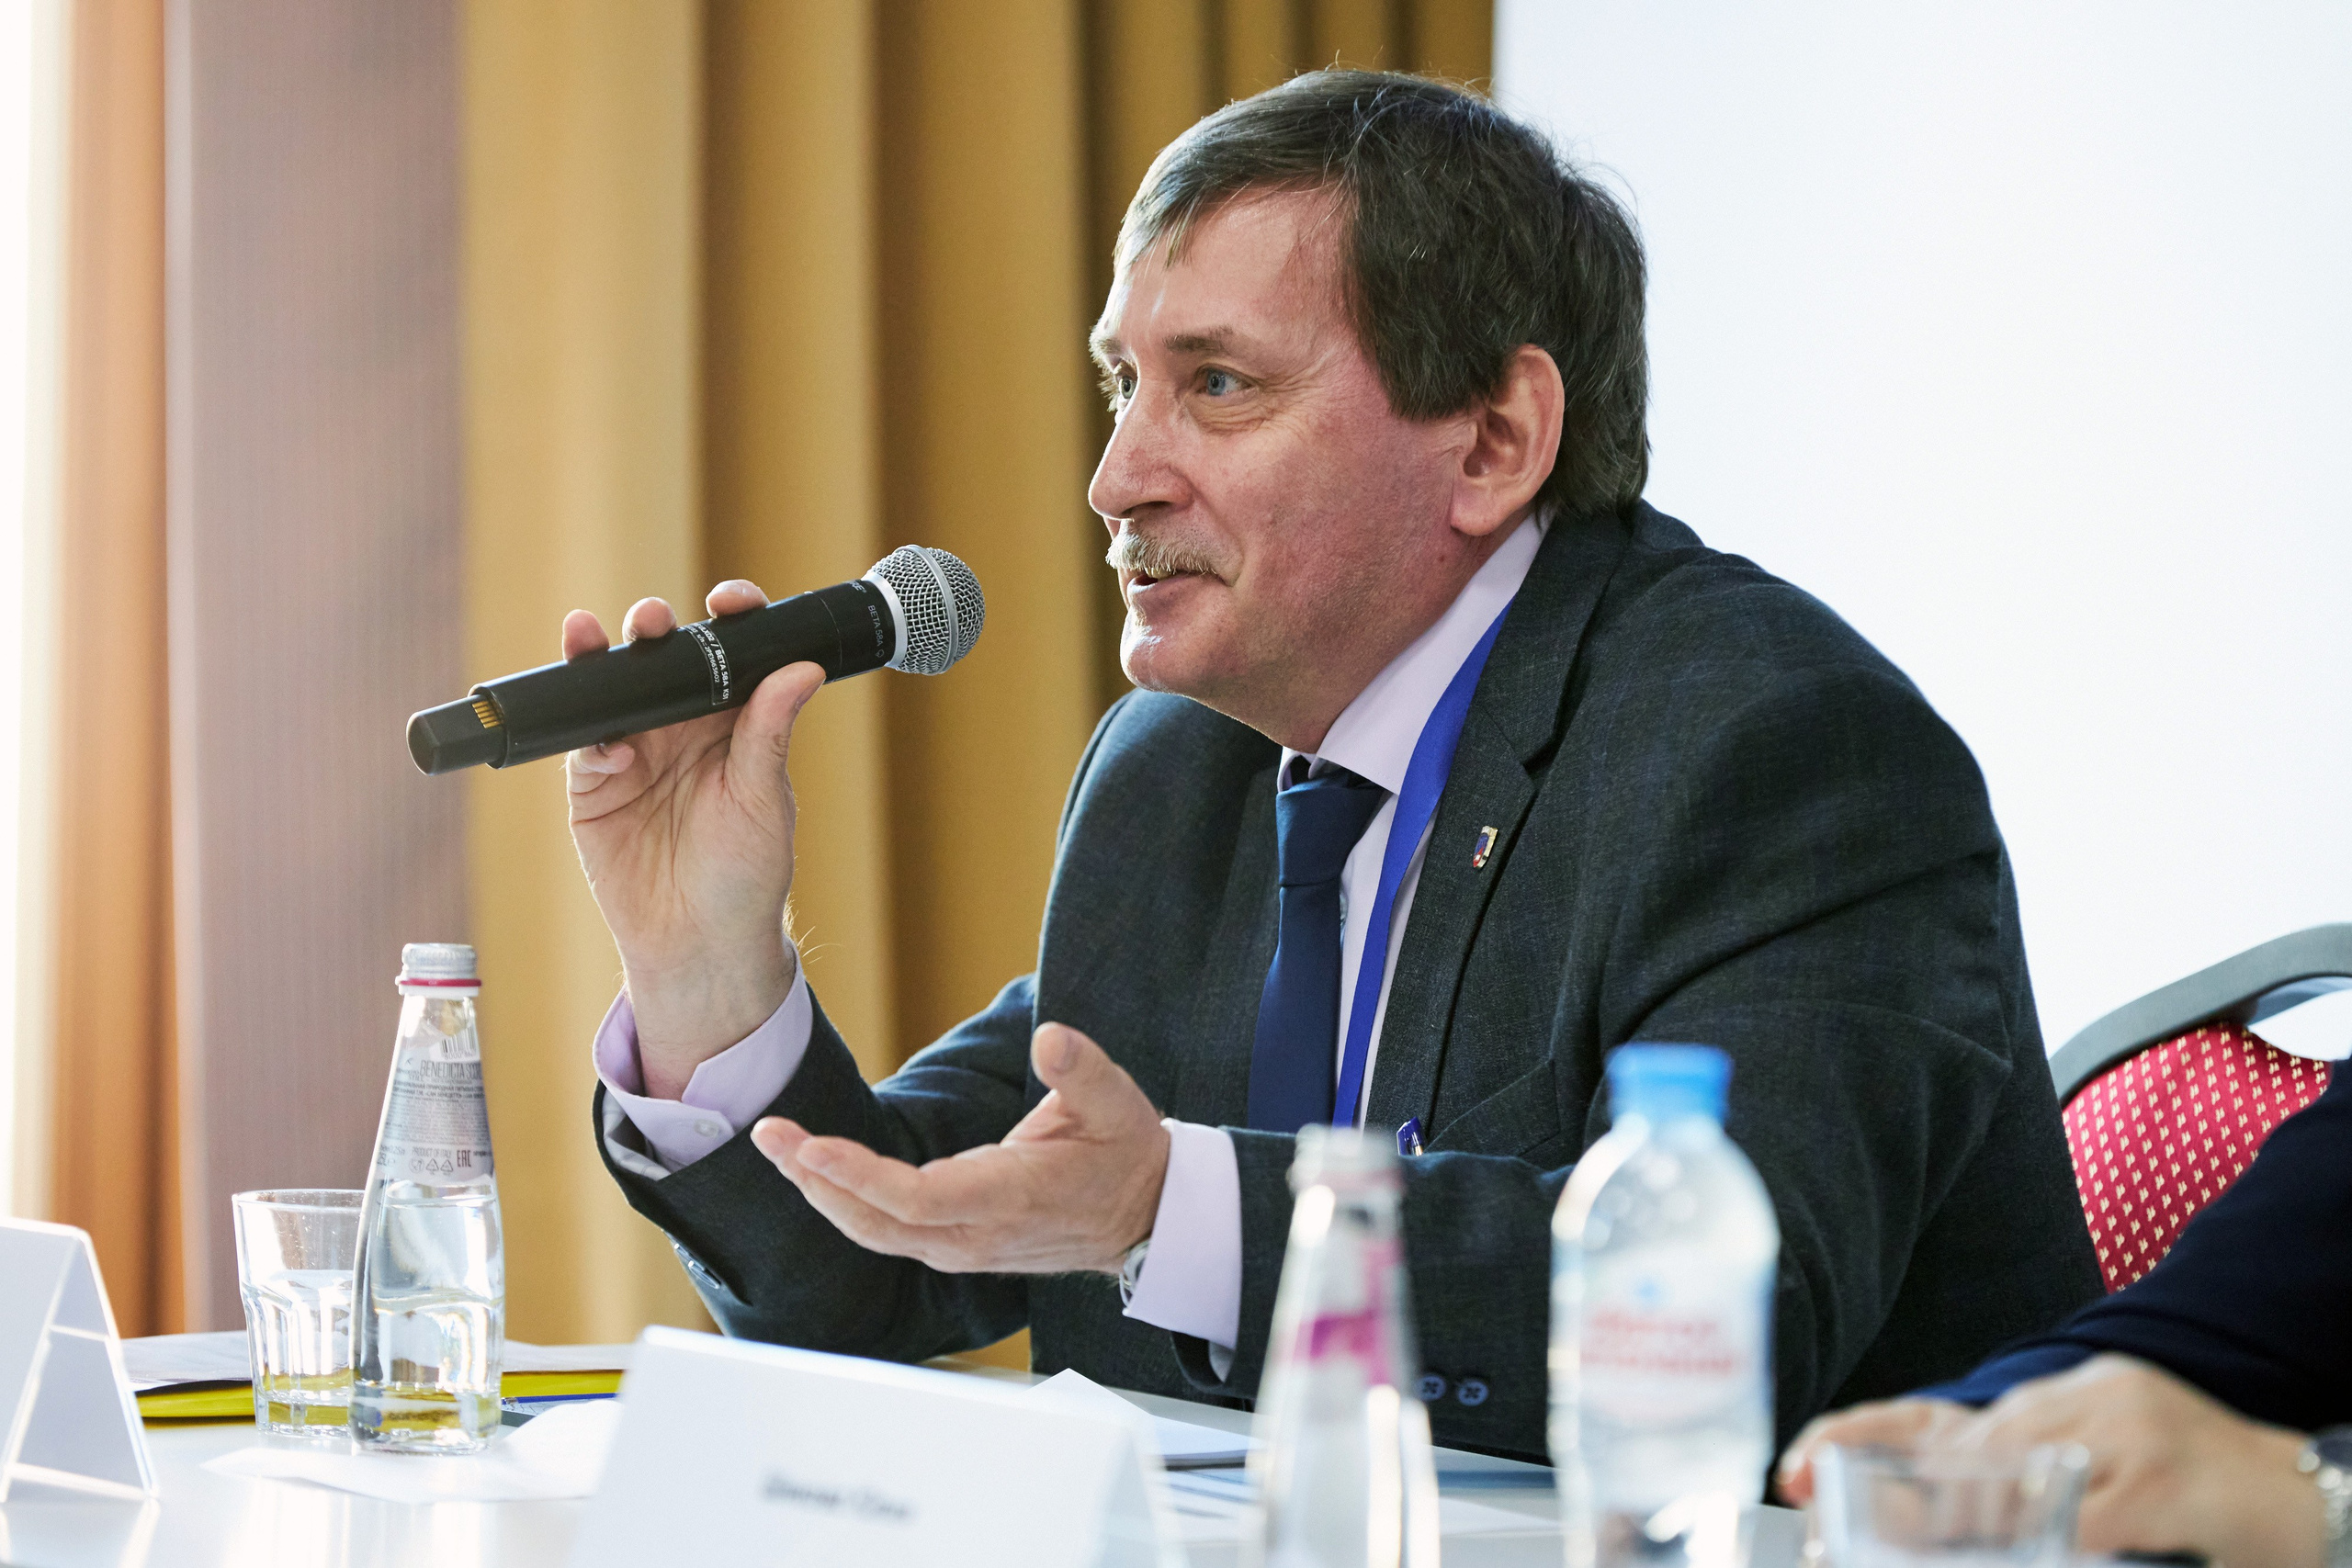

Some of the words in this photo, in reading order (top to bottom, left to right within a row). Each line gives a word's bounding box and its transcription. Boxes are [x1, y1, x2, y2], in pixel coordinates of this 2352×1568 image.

[868, 604, 881, 629] BETA
[876, 629, 884, 647] 58A
[715, 649, 726, 671] BETA
[419, 1059, 465, 1079] BENEDICTA
[413, 1145, 433, 1156] PRODUCT
